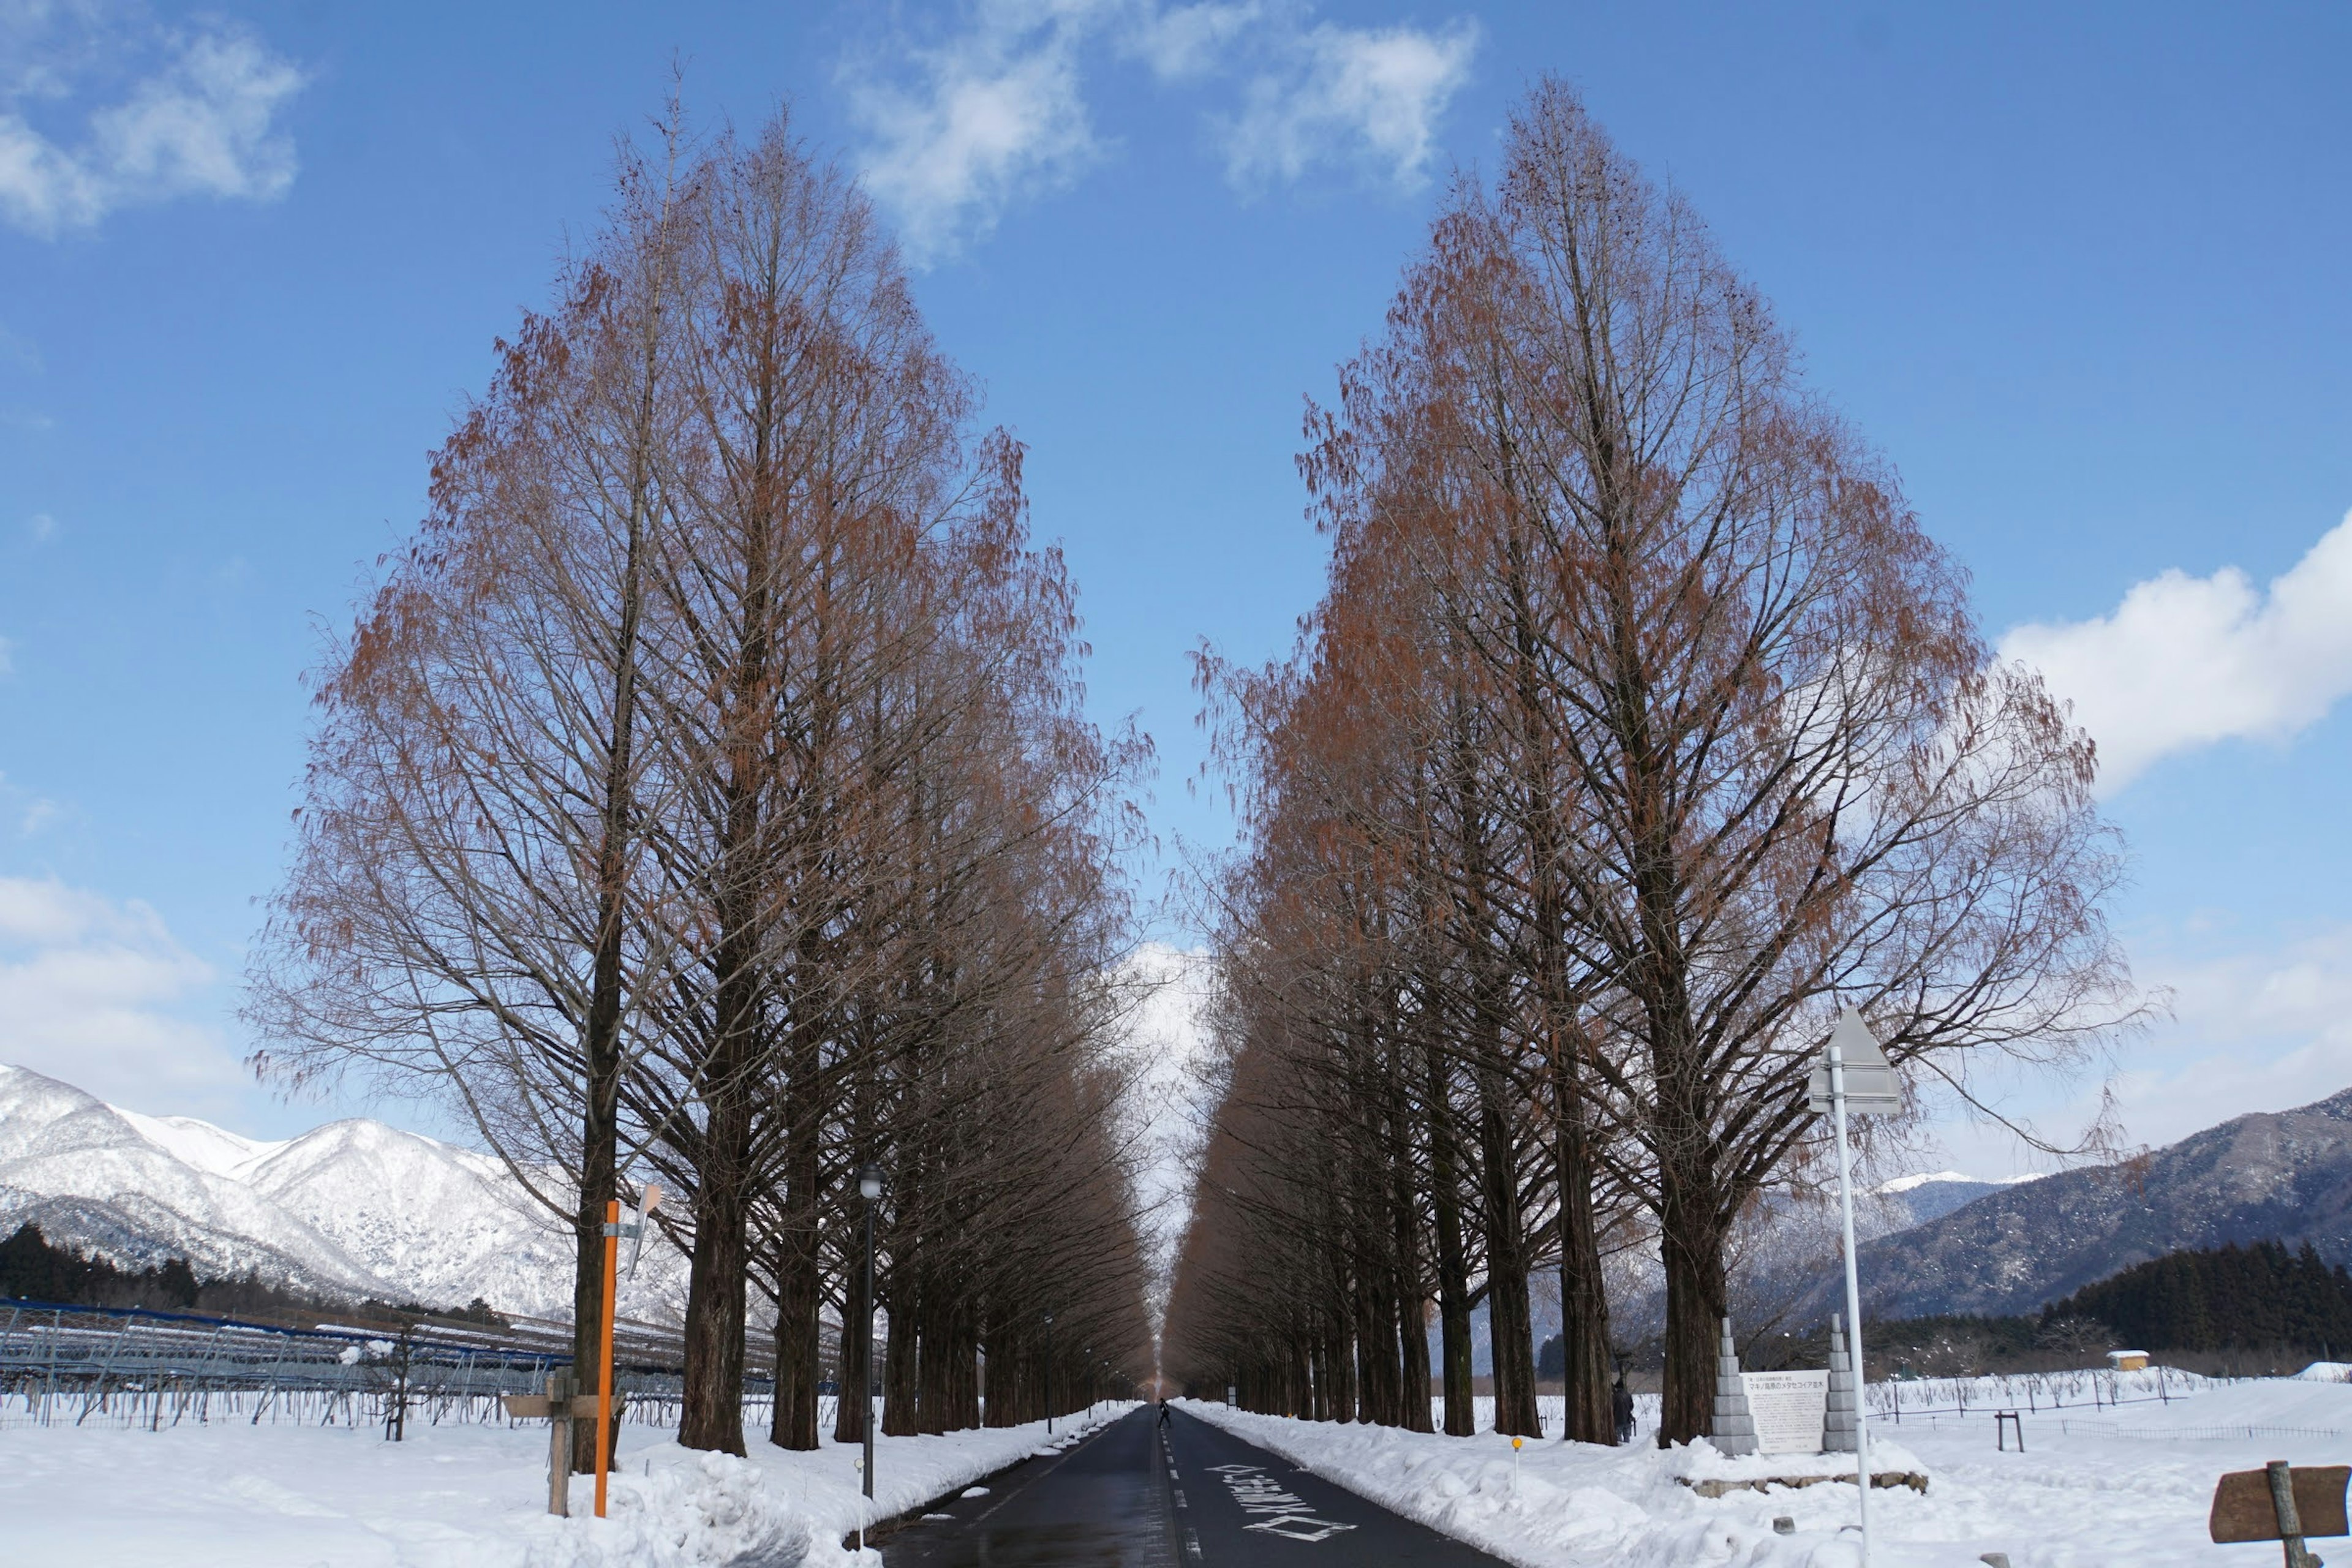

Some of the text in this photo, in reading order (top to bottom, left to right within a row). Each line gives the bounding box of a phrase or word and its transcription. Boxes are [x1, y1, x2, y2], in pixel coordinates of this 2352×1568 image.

[1749, 1381, 1824, 1390] マキノ高原のメタセコイア並木
